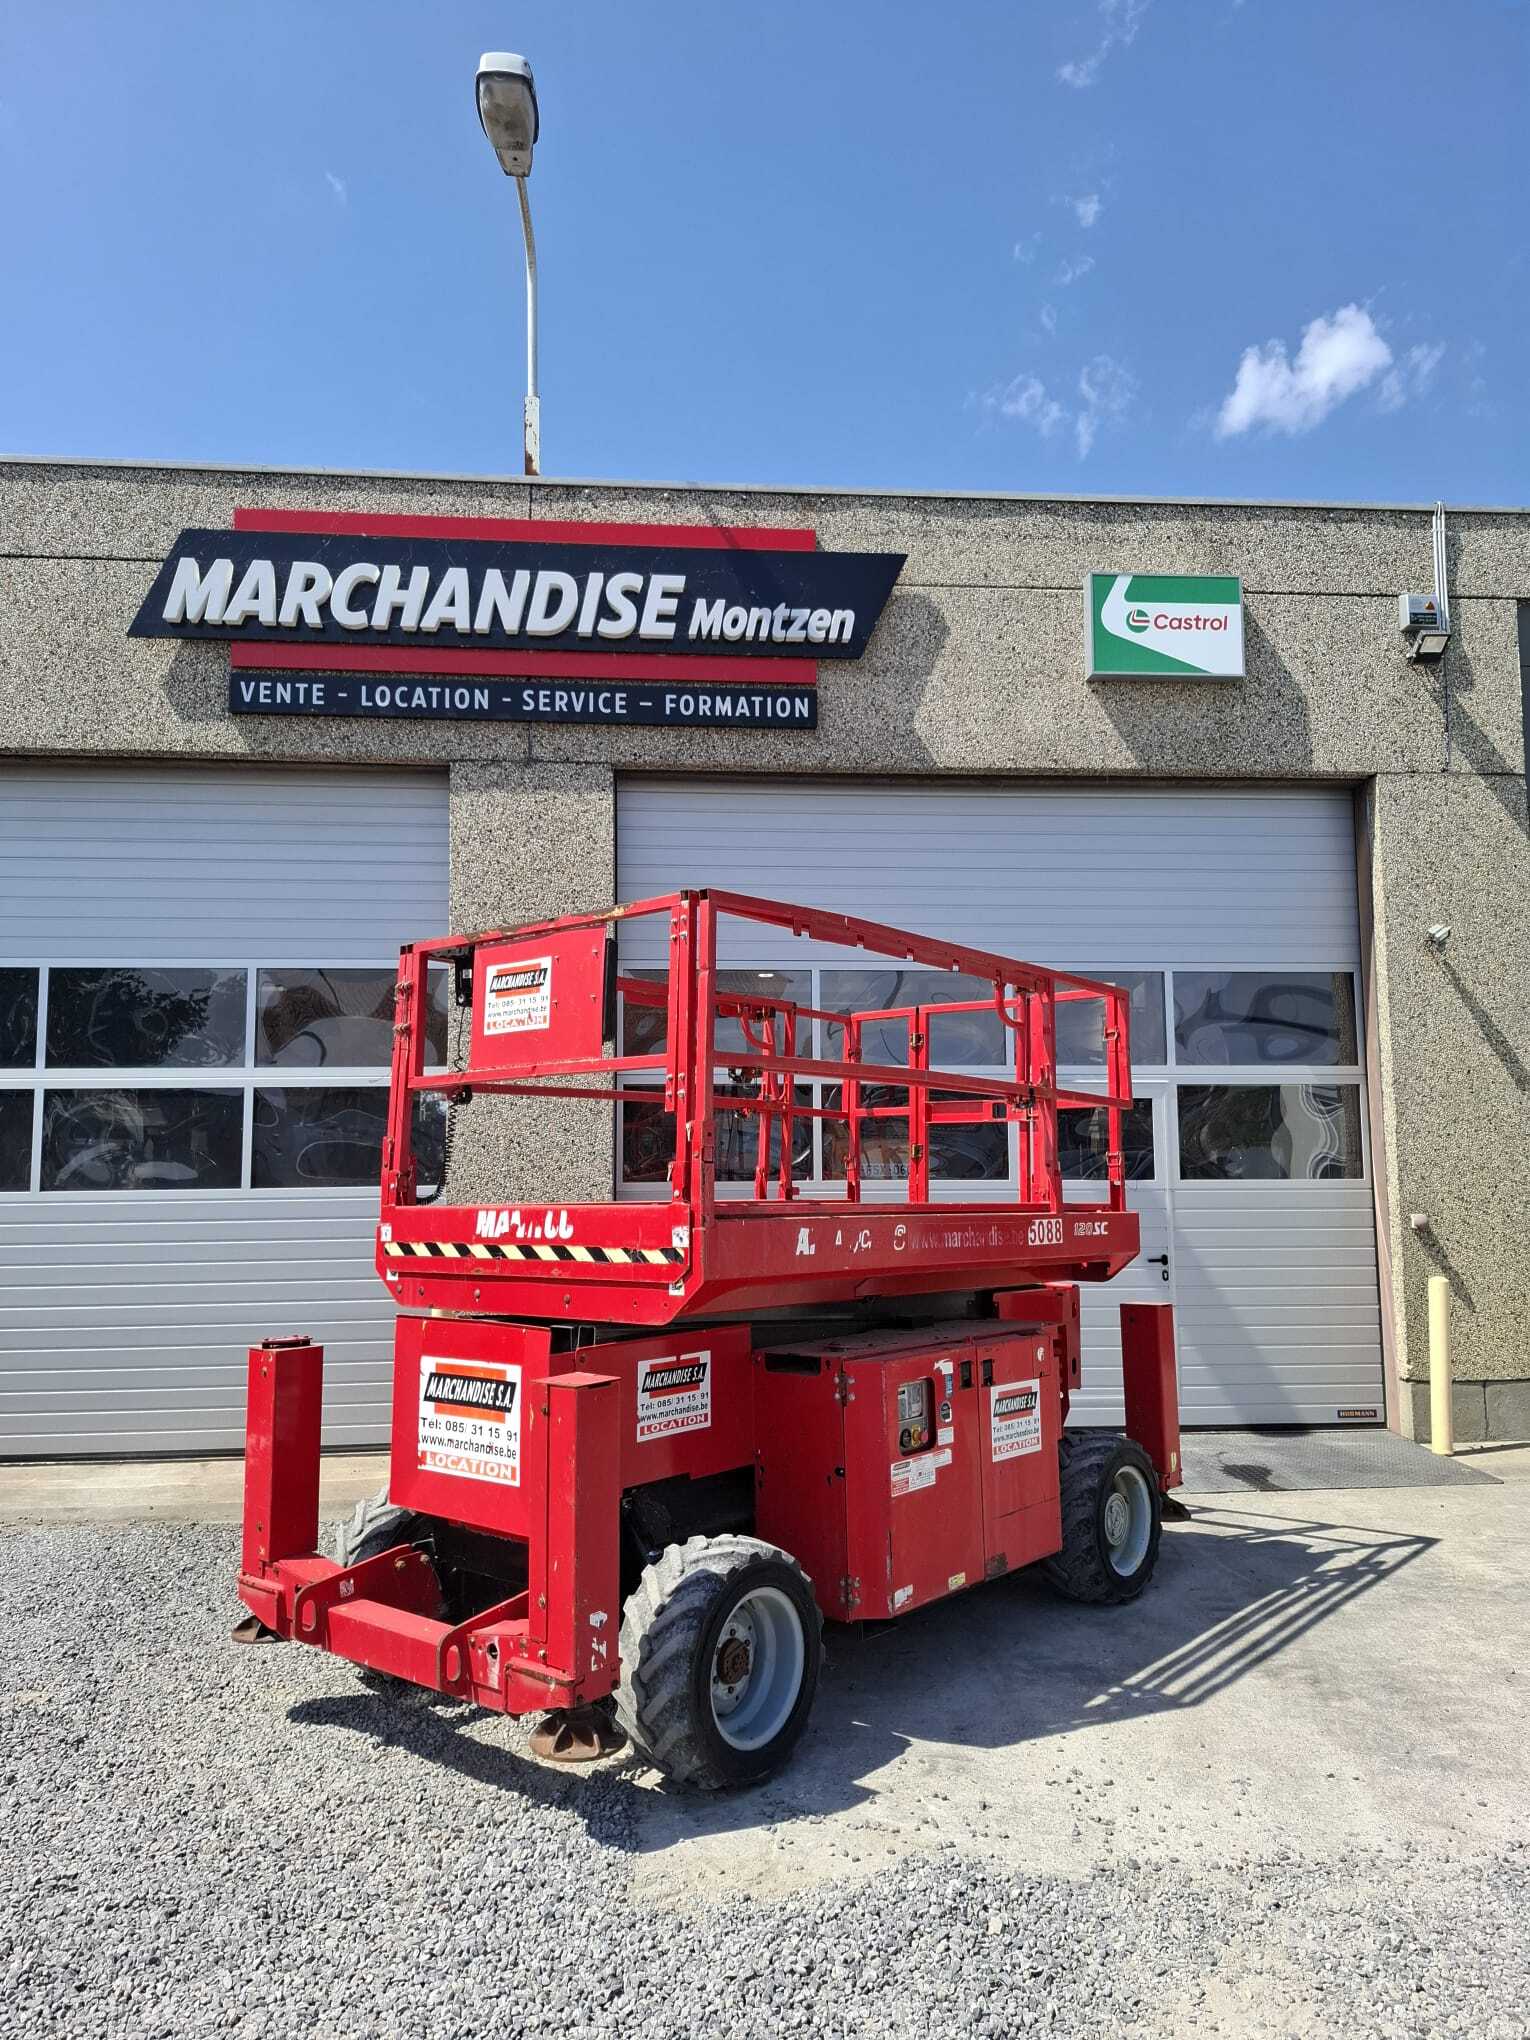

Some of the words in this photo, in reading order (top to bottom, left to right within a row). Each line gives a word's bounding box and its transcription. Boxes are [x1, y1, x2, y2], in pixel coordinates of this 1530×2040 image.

[162, 557, 687, 640] MARCHANDISE
[688, 598, 856, 643] Montzen
[1153, 614, 1228, 631] Castrol
[240, 681, 326, 705] VENTE
[361, 685, 490, 710] LOCATION
[522, 690, 628, 714] SERVICE
[665, 694, 810, 718] FORMATION
[1029, 1219, 1062, 1243] 5088
[644, 1367, 692, 1389] MARCHANDISE
[426, 1376, 496, 1405] MARCHANDISE
[496, 1384, 513, 1408] S.A.
[676, 1396, 684, 1404] 31
[688, 1394, 697, 1402] 15
[701, 1392, 709, 1400] 91
[640, 1402, 708, 1421] www.marchandise.be
[471, 1424, 483, 1436] 31
[489, 1427, 500, 1439] 15
[506, 1430, 518, 1442] 91
[644, 1414, 705, 1434] LOCATION
[421, 1434, 517, 1460] www.marchandise.be
[996, 1438, 1039, 1454] LOCATION
[426, 1452, 512, 1479] LOCATION
